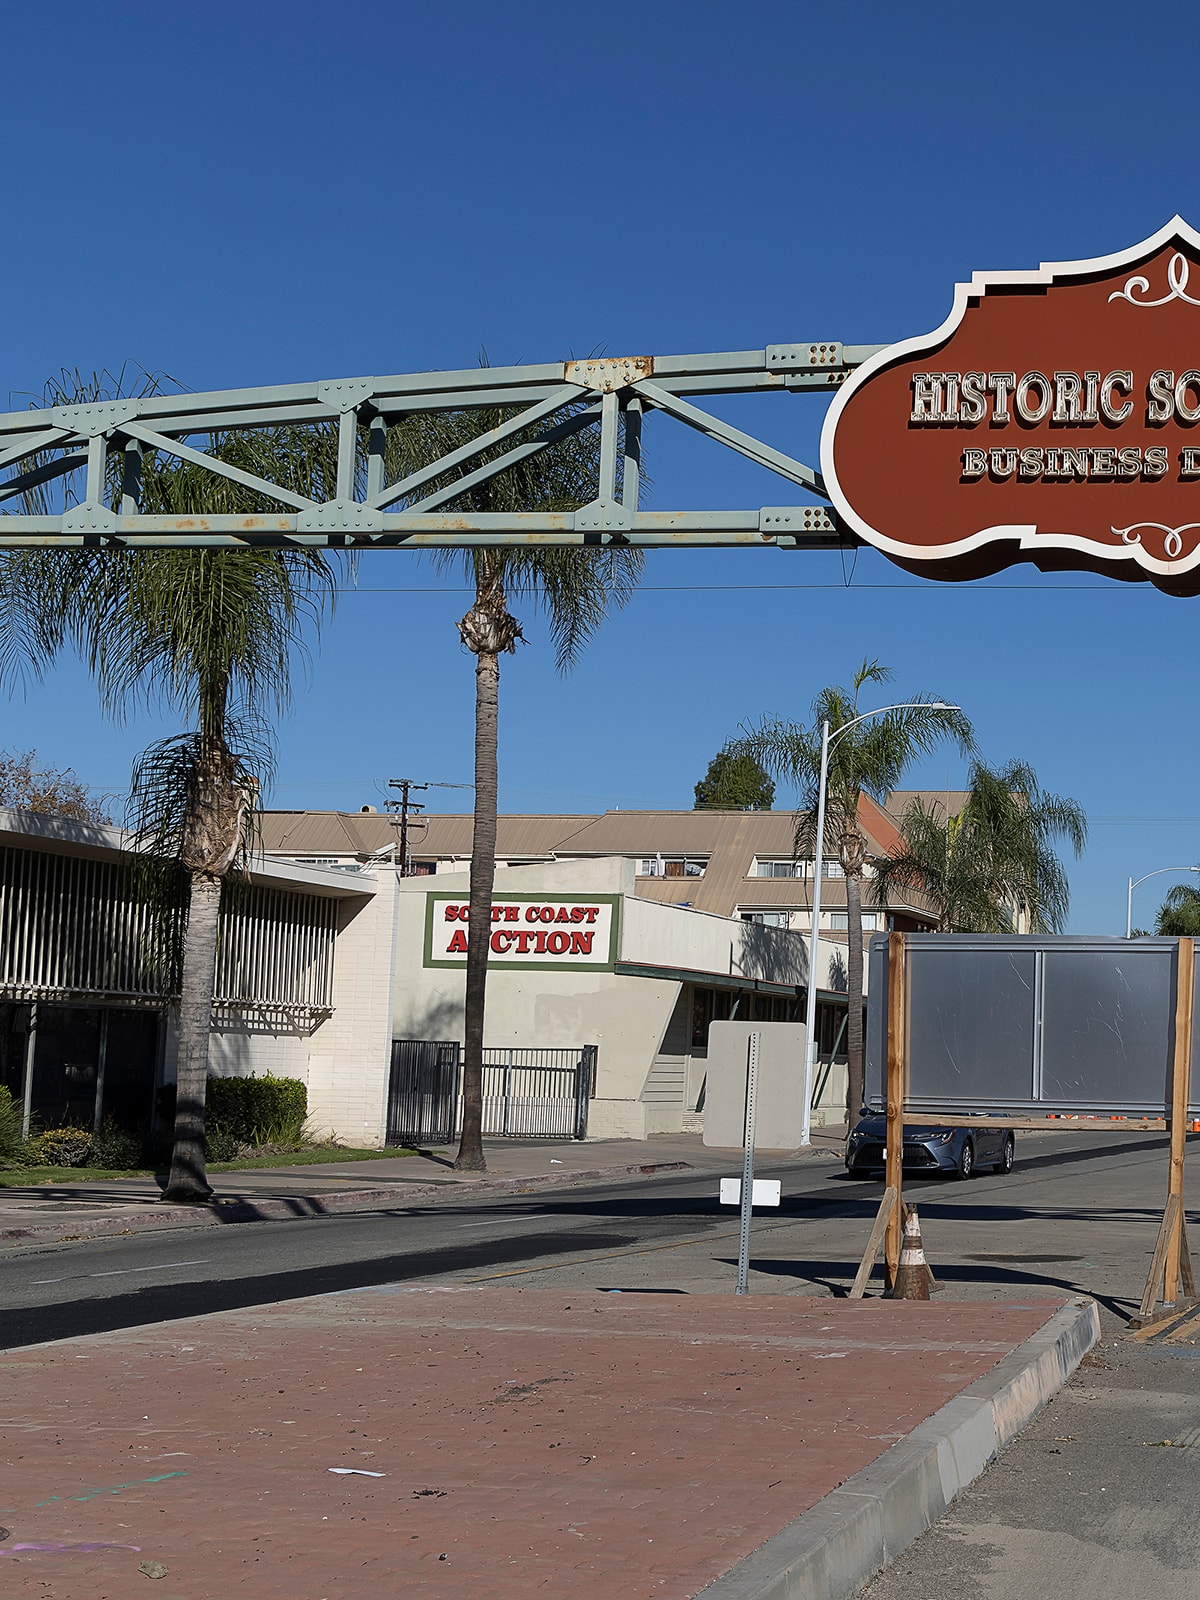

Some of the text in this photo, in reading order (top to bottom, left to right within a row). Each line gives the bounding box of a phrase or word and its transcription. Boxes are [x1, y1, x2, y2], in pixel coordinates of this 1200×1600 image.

[909, 370, 1134, 425] HISTORIC
[961, 447, 1169, 478] BUSINESS
[445, 905, 599, 923] SOTH COAST
[446, 930, 595, 954] ACTION
